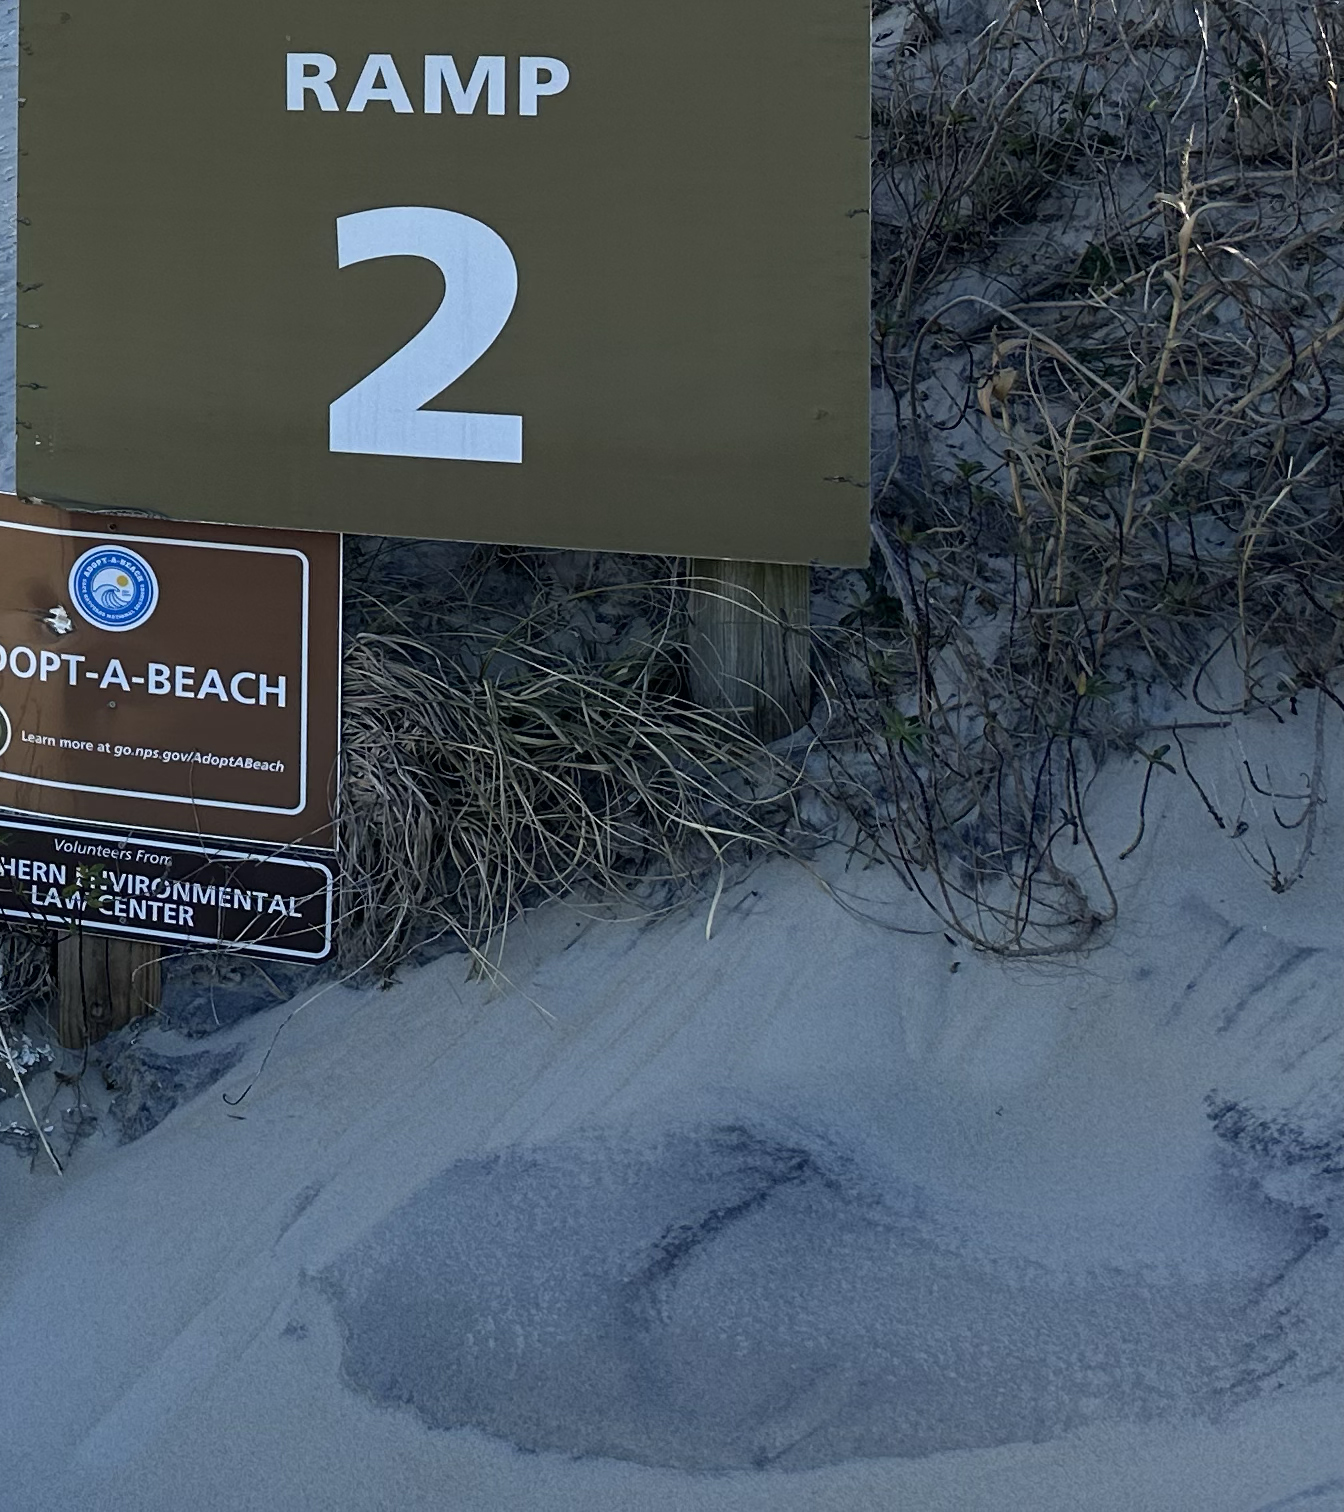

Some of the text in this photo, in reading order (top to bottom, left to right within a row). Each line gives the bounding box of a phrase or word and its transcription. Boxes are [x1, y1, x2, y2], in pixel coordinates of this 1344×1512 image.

[286, 52, 570, 116] RAMP
[329, 206, 523, 464] 2
[83, 556, 144, 583] ADOPT-A-BEACH
[21, 729, 284, 773] Learn more at go.nps.gov/AdoptABeach
[53, 837, 173, 868] Volunteers From
[97, 893, 195, 928] CENTER
